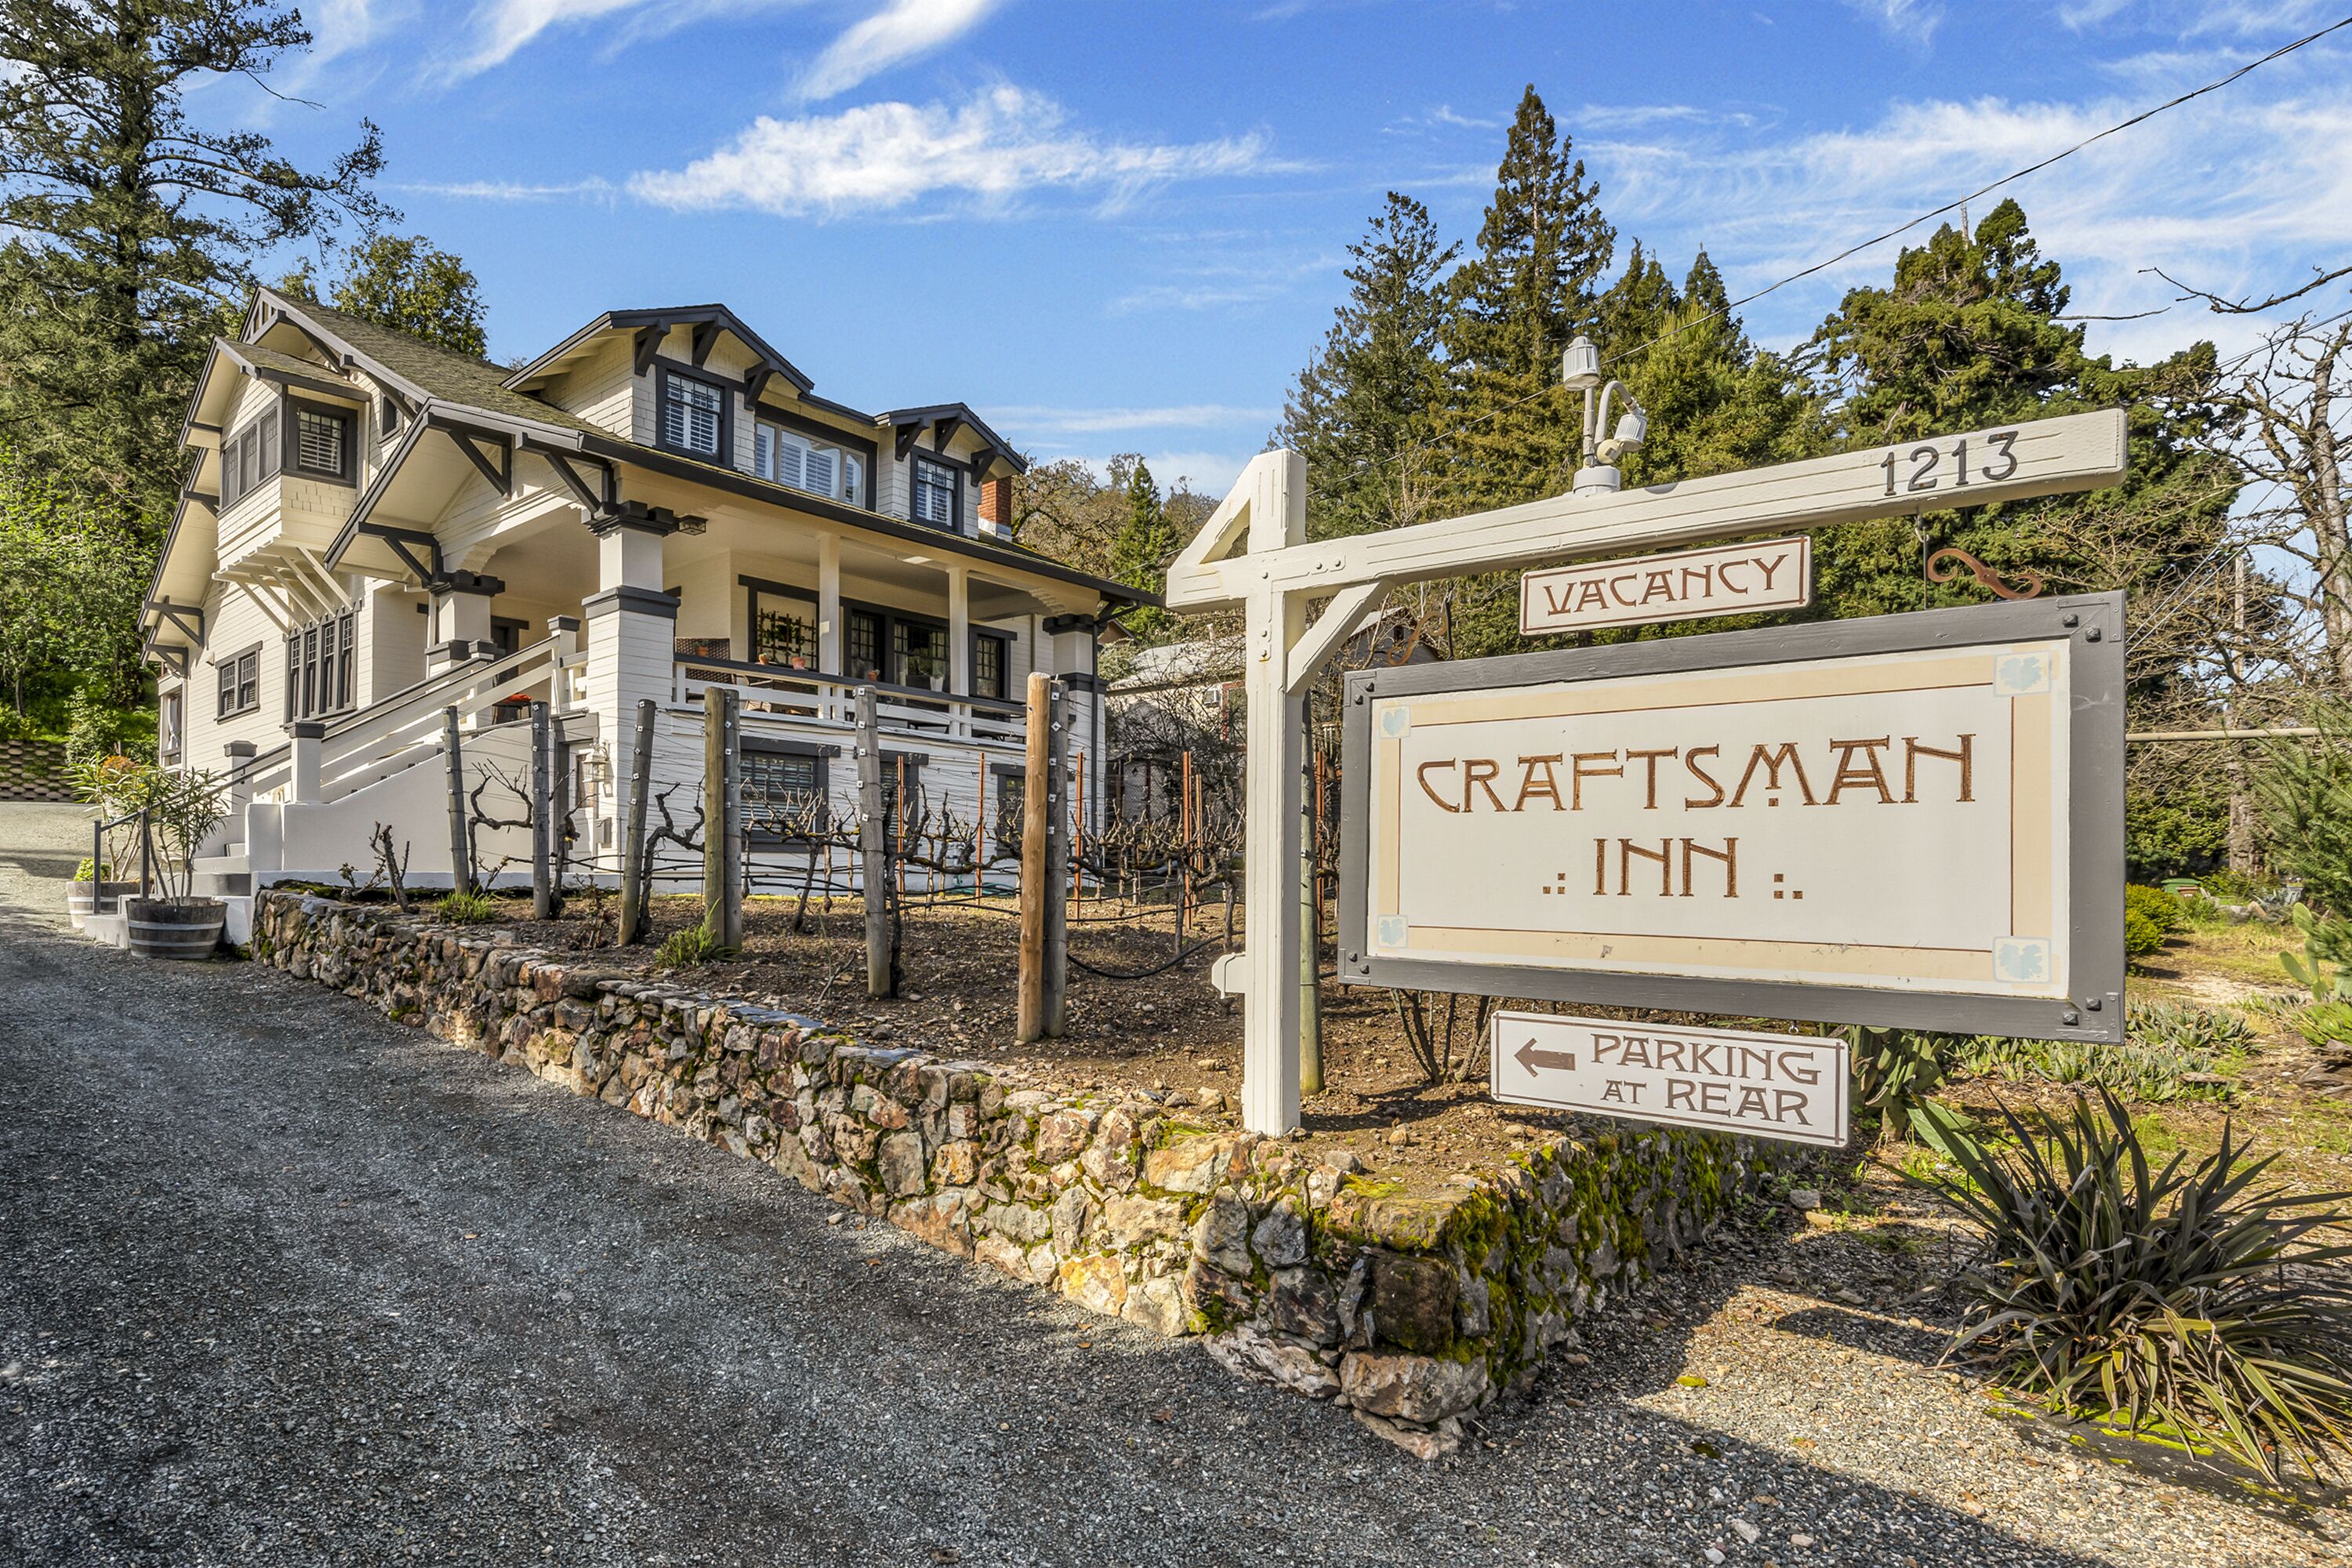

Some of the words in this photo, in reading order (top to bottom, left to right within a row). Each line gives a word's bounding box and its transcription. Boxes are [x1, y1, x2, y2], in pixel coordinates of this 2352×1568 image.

[1881, 431, 2019, 496] 1213
[1547, 554, 1787, 615] VACANCY
[1417, 734, 1976, 814] CRAFTSMAN
[1593, 837, 1740, 898] INN
[1590, 1033, 1822, 1085] PARKING
[1600, 1079, 1647, 1105] AT
[1664, 1078, 1813, 1127] REAR
